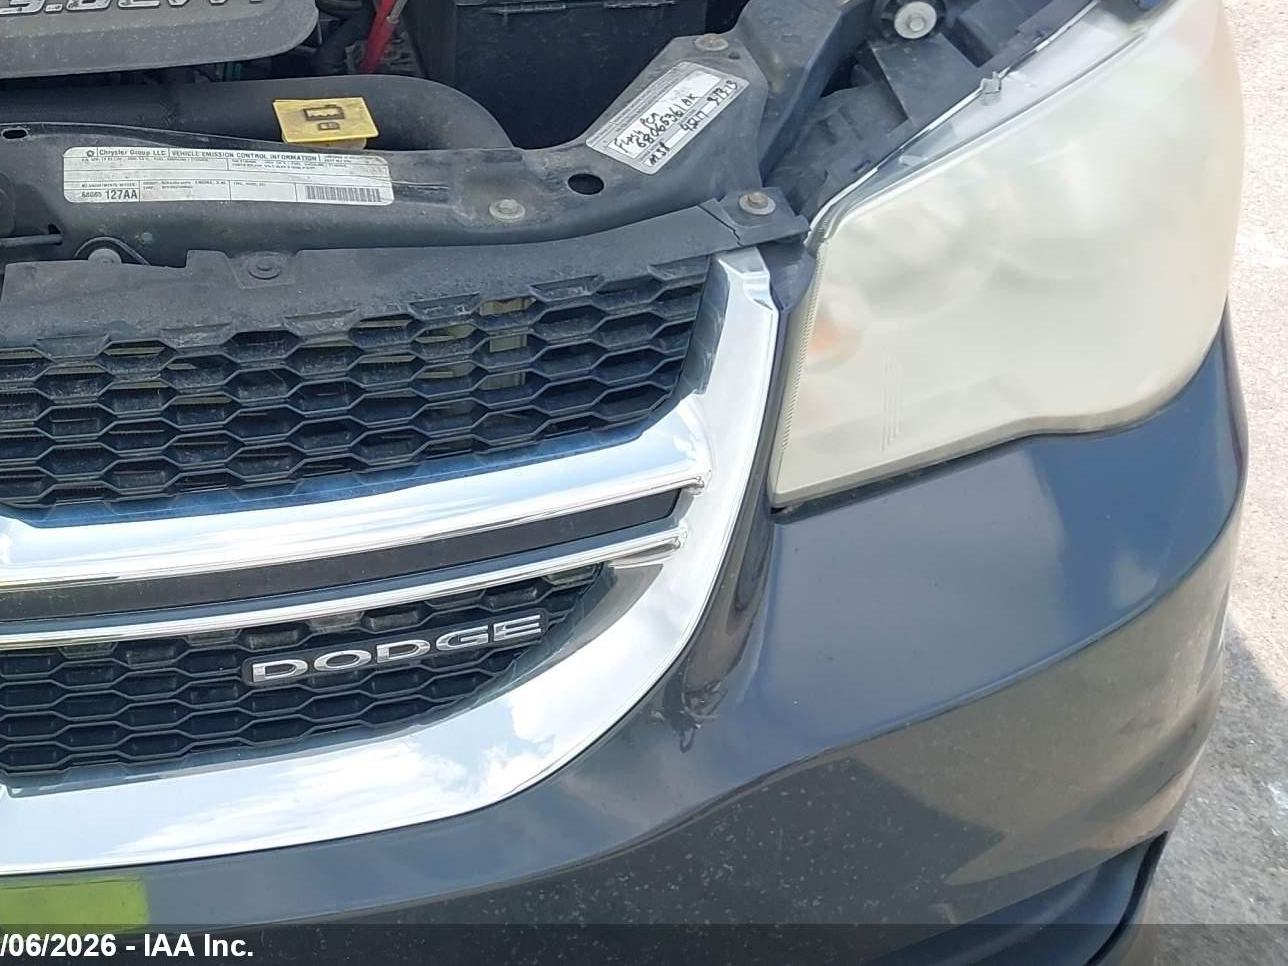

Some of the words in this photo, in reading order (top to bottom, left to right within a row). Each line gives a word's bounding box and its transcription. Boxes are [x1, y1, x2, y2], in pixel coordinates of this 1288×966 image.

[130, 149, 150, 157] Group
[236, 152, 267, 160] CONTROL
[270, 153, 317, 161] INFORMATION
[105, 189, 137, 200] 127AA
[252, 614, 542, 683] DODGE
